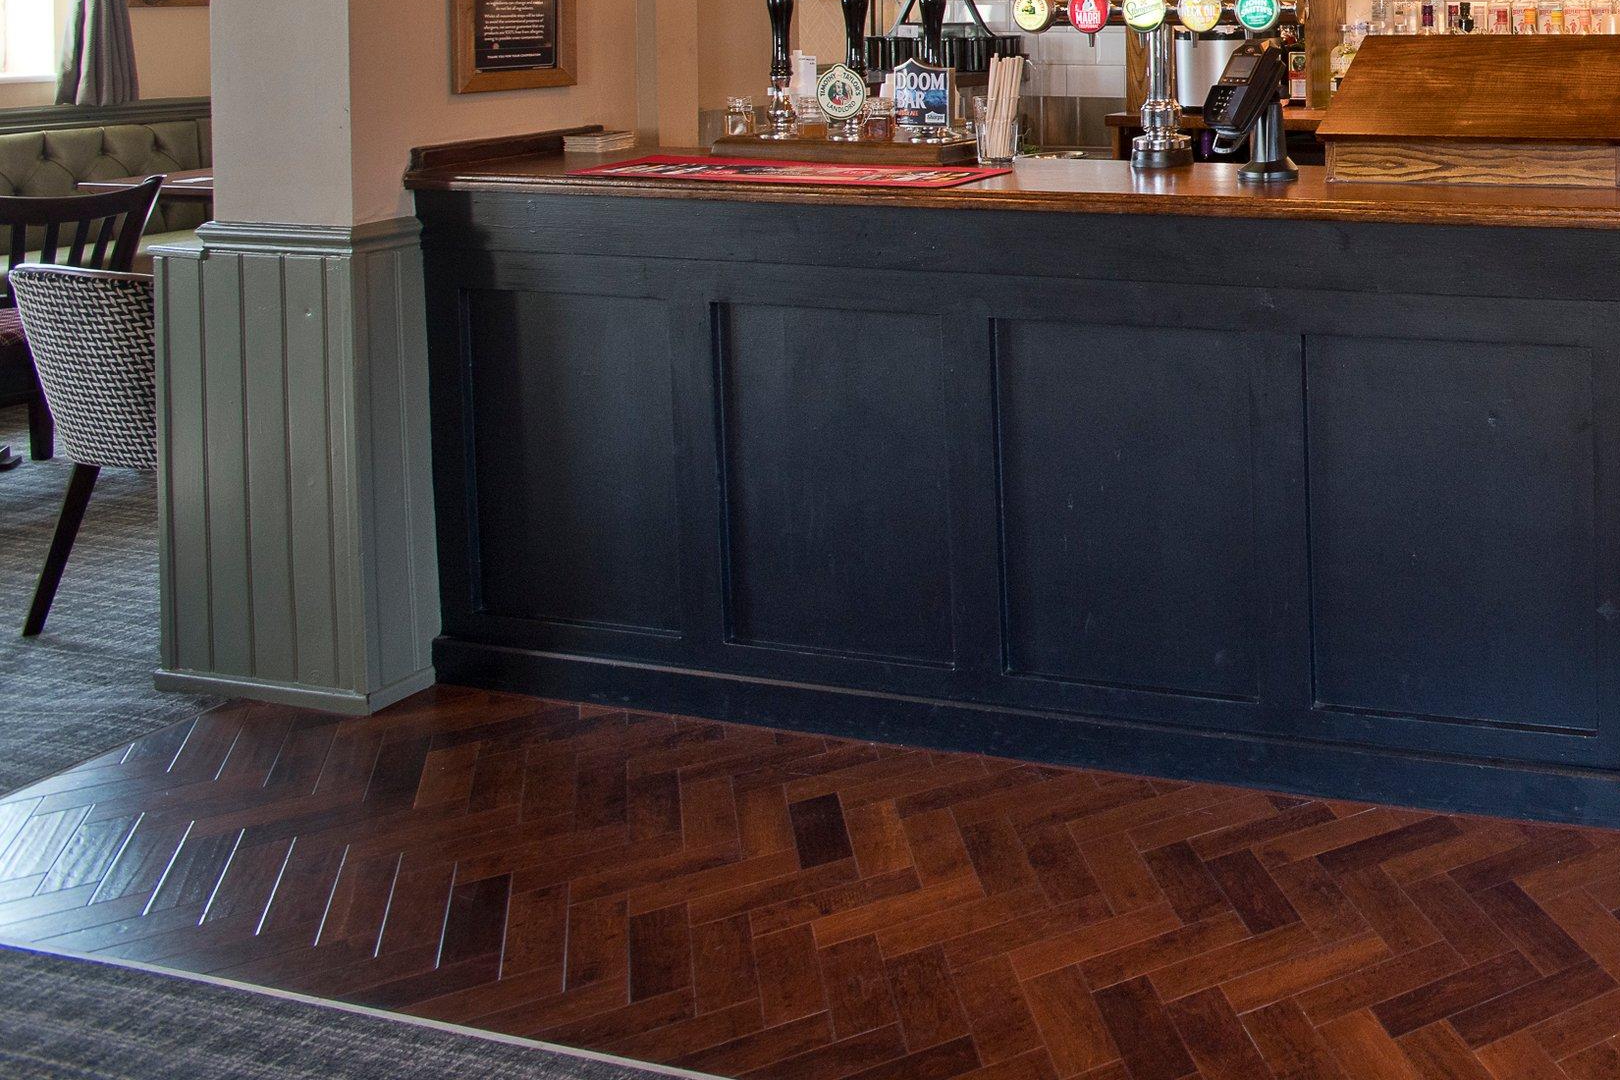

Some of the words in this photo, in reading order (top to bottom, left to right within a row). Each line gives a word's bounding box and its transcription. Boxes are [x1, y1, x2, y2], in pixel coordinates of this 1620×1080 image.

[820, 73, 836, 97] TIMOTHY
[842, 72, 860, 97] TAYLOR'S
[896, 72, 945, 90] DOOM
[826, 100, 856, 113] LANDLORD
[896, 89, 927, 109] BAR
